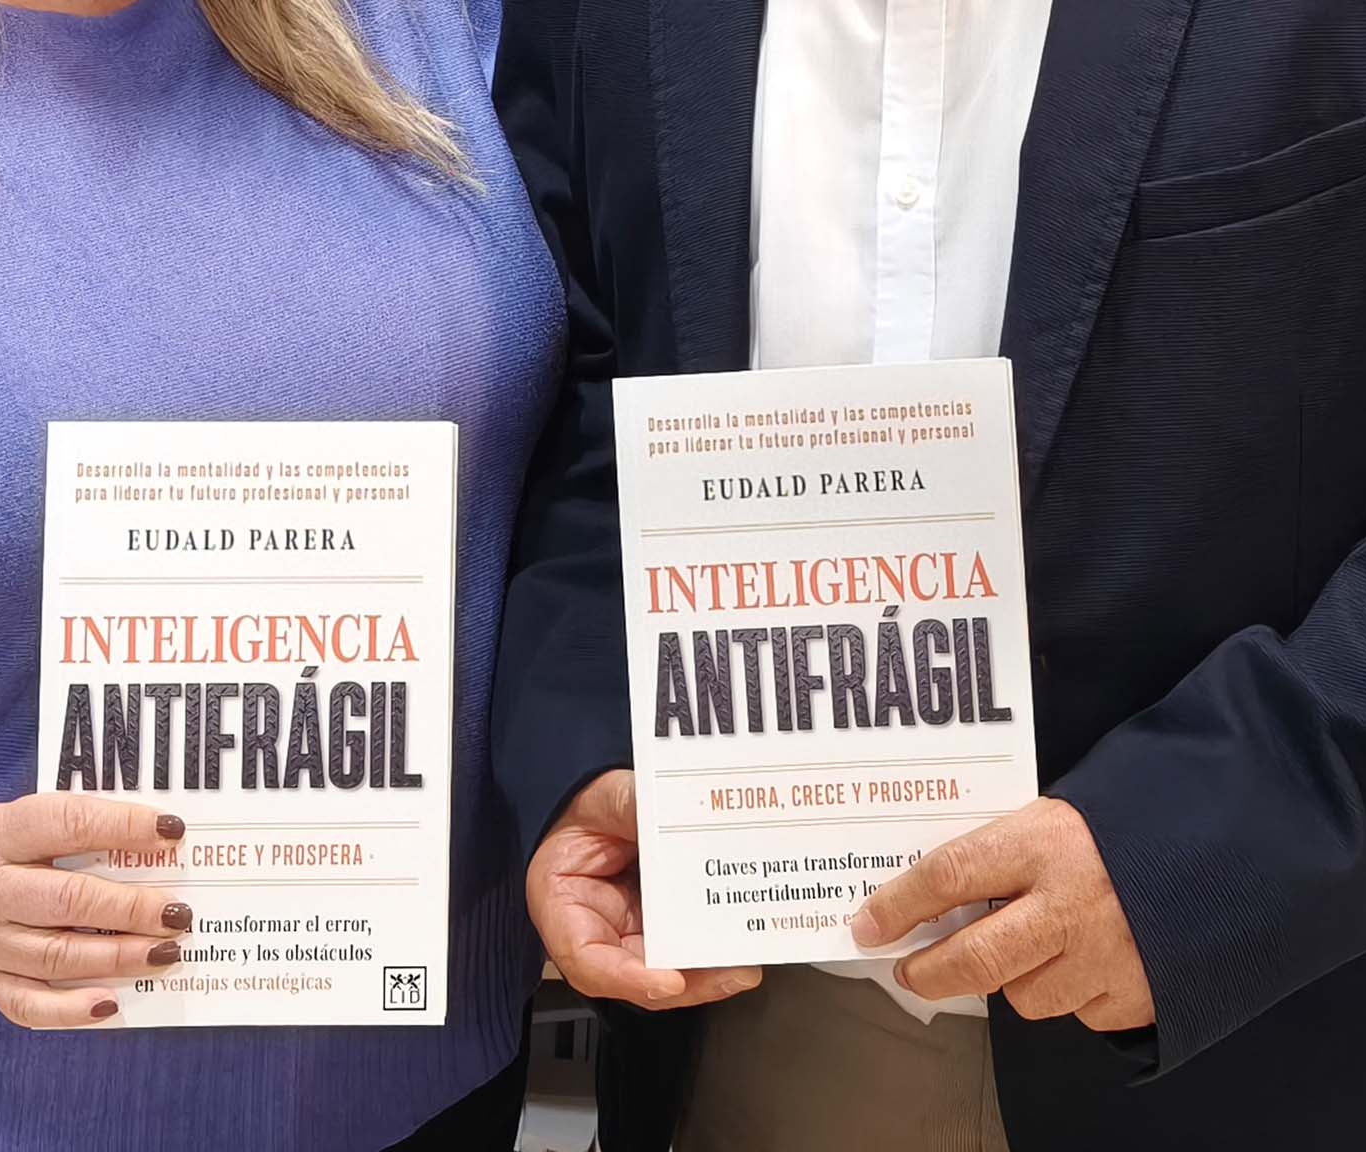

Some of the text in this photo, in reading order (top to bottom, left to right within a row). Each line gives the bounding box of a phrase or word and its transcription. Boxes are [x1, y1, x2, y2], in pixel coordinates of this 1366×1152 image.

[647, 401, 973, 433] Desarrolla la mentalidad y las competencias
[649, 422, 975, 459] para liderar tu futuro profesional y personal
[76, 461, 410, 480] Desarrolla la mentalidad y las competencias
[75, 485, 411, 504] para liderar tu futuro profesional y personal
[702, 468, 926, 502] EUDALD PARERA
[127, 528, 356, 551] EUDALD PARERA
[644, 550, 999, 615] INTELIGENCIA
[59, 614, 420, 664] INTELIGENCIA
[653, 604, 1014, 739] ANTIFRÁGIL
[55, 666, 424, 793] ANTIFRÁGIL
[711, 778, 960, 811] MEJORA, CRECE Y PROSPERA
[107, 843, 364, 870] MEJORA, CRECE Y PROSPERA
[705, 857, 757, 878] Claves
[762, 858, 799, 879] para
[803, 851, 903, 872] transformar
[706, 880, 857, 906] la incertidumbre y
[199, 914, 301, 935] transformar
[306, 914, 321, 933] el
[325, 916, 373, 936] error,
[746, 914, 766, 932] en
[771, 911, 838, 932] ventajas
[243, 947, 251, 966] y
[256, 944, 280, 962] los
[285, 943, 373, 963] obstáculos
[135, 973, 333, 996] en ventajas estratégicas
[389, 989, 422, 1004] LID
